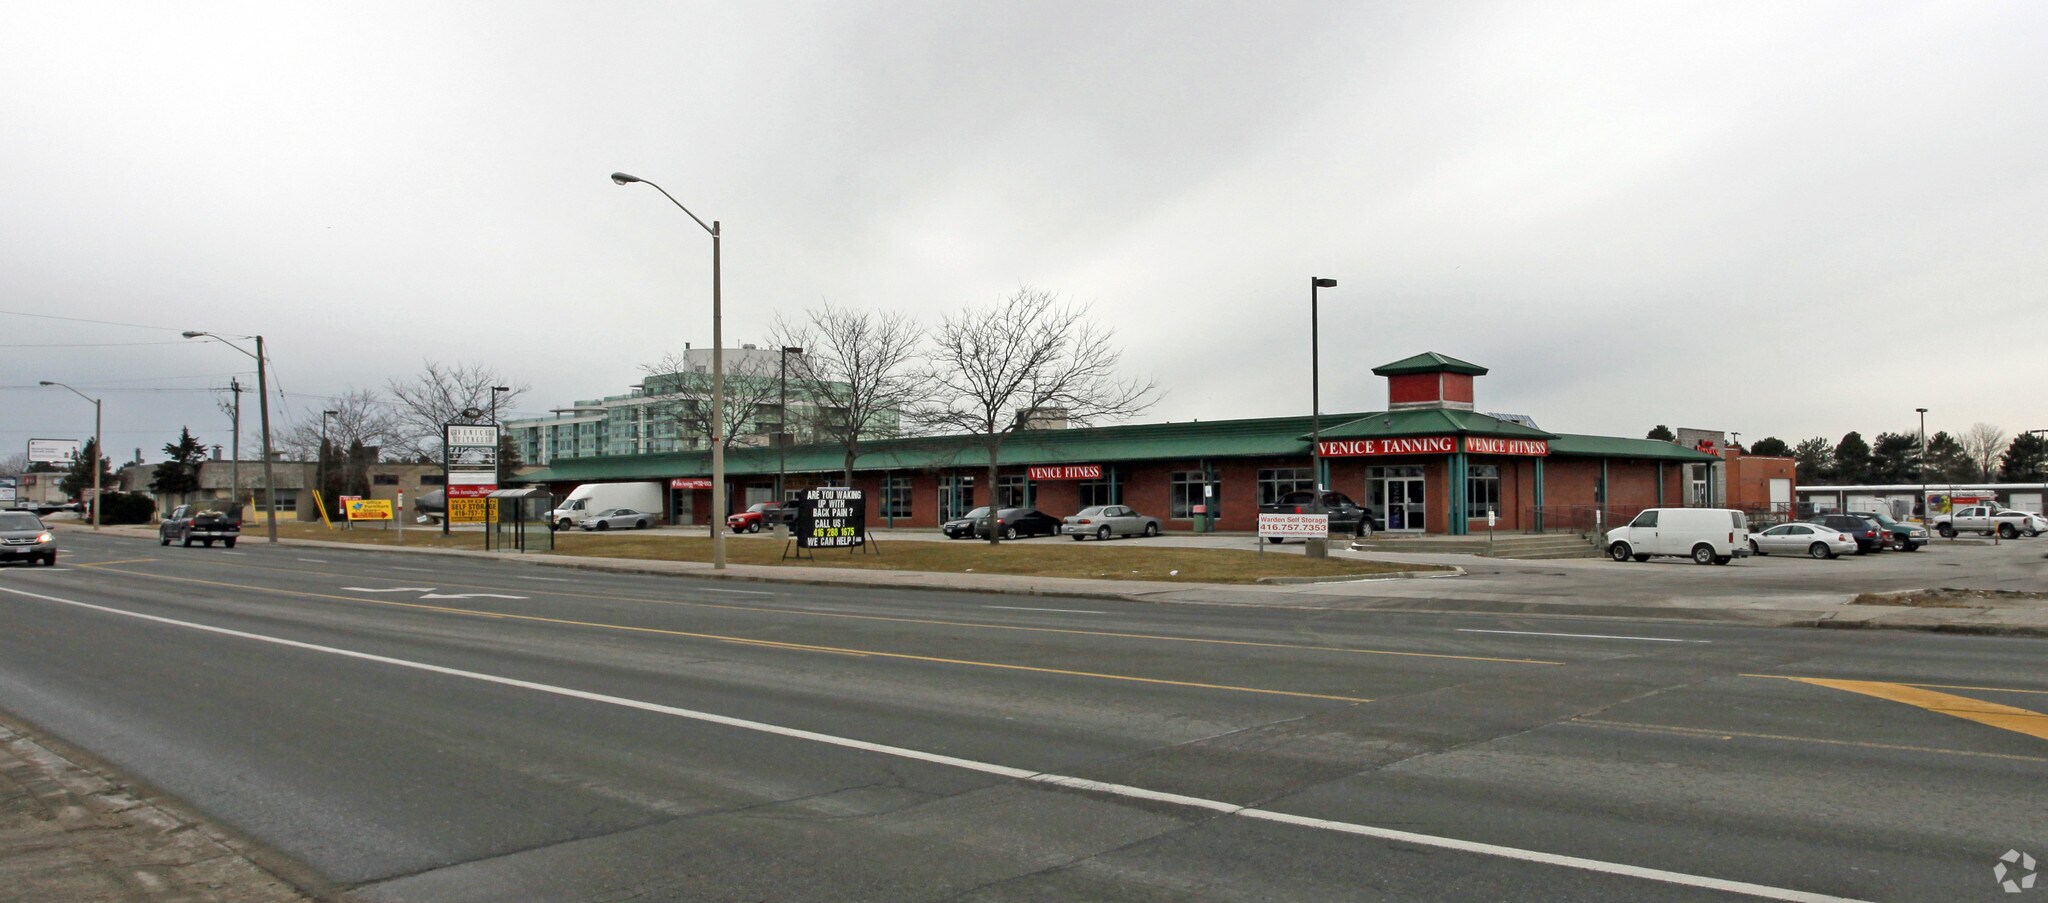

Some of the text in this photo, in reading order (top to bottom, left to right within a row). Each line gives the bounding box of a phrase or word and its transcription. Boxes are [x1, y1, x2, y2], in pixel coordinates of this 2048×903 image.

[1319, 437, 1451, 455] VENICE TANNING
[1467, 439, 1546, 454] VENICE FITNESS
[1031, 466, 1099, 478] VENICE FITNESS
[807, 490, 862, 500] ARE YOU WAKING
[817, 500, 845, 508] UP WITH
[812, 508, 830, 517] BACK
[815, 519, 831, 528] CALL
[813, 528, 824, 537] 416
[841, 527, 855, 536] 1675
[807, 537, 818, 546] WE
[820, 537, 834, 546] CAN
